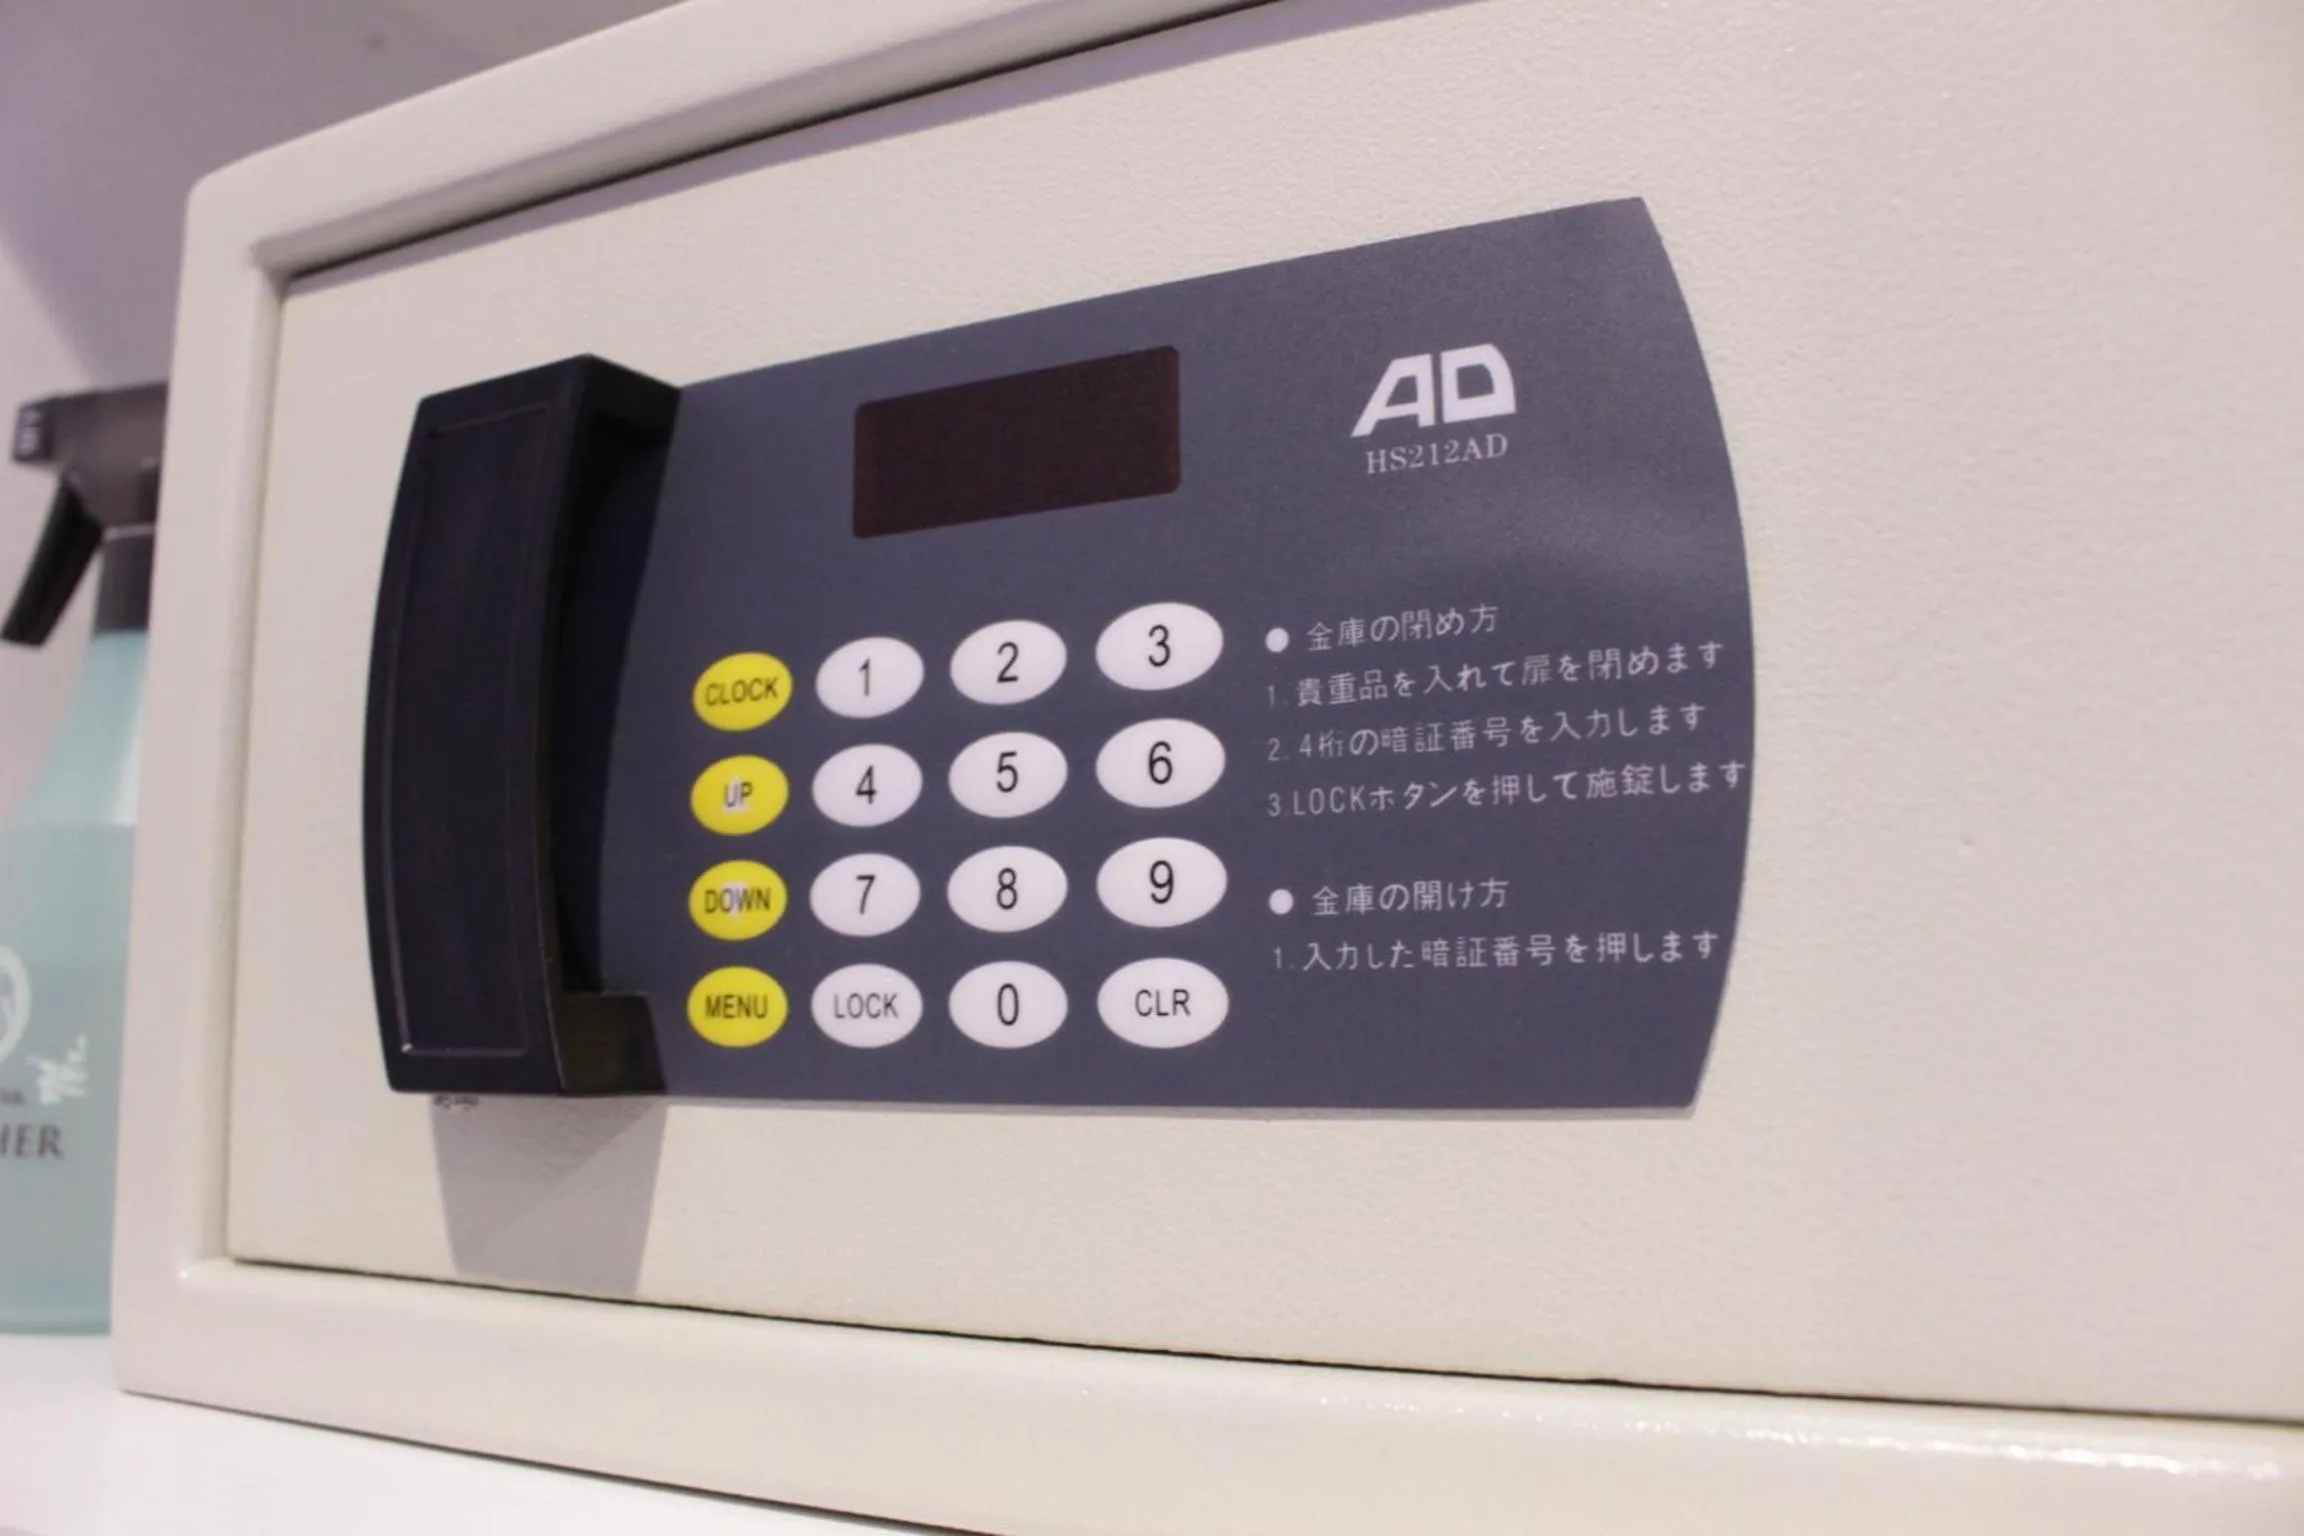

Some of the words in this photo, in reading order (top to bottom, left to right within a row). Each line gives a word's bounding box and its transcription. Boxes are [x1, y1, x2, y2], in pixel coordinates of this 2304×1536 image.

[1365, 432, 1509, 475] HS212AD
[1148, 624, 1172, 668] 3
[1306, 603, 1499, 652] 金庫の閉め方
[859, 658, 872, 697] 1
[997, 641, 1019, 683] 2
[705, 676, 780, 706] CLOCK
[997, 751, 1019, 793] 5
[1148, 741, 1173, 785] 6
[723, 781, 753, 808] UP
[856, 765, 877, 804] 4
[704, 887, 771, 914] DOWN
[856, 875, 876, 914] 7
[997, 868, 1018, 910] 8
[1149, 860, 1175, 904] 9
[1312, 878, 1509, 916] 金庫の開け方
[705, 994, 768, 1019] MENU
[834, 993, 898, 1019] LOCK
[997, 983, 1019, 1026] 0
[1135, 989, 1190, 1017] CLR
